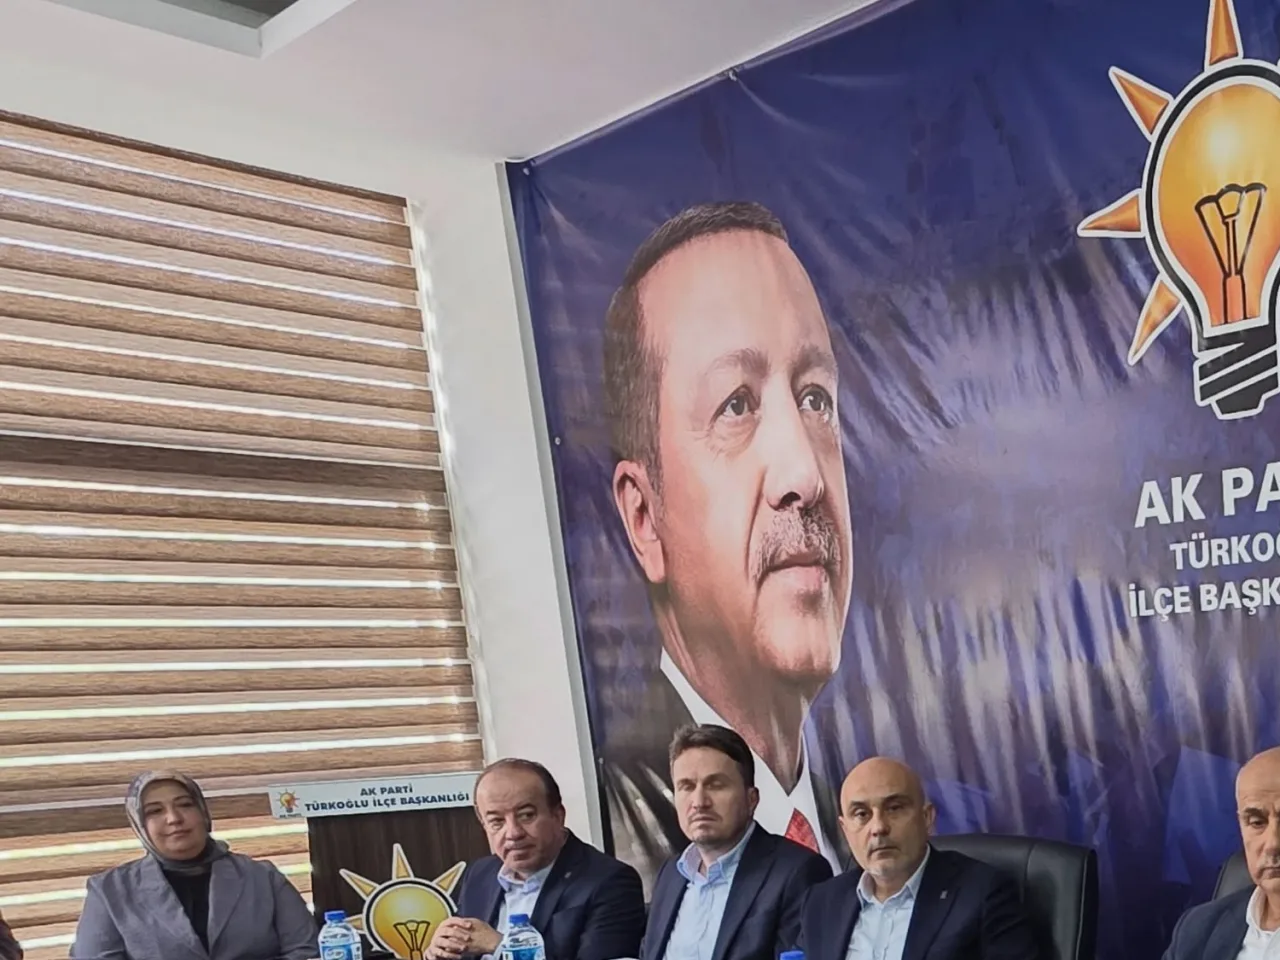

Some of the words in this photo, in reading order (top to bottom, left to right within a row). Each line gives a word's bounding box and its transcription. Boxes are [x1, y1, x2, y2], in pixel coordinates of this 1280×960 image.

[1134, 473, 1206, 528] AK
[1128, 582, 1192, 622] İLÇE
[305, 799, 369, 812] TÜRKOĞLU
[372, 796, 398, 808] İLÇE
[401, 792, 470, 806] BAŞKANLIĞI
[360, 787, 377, 797] AK
